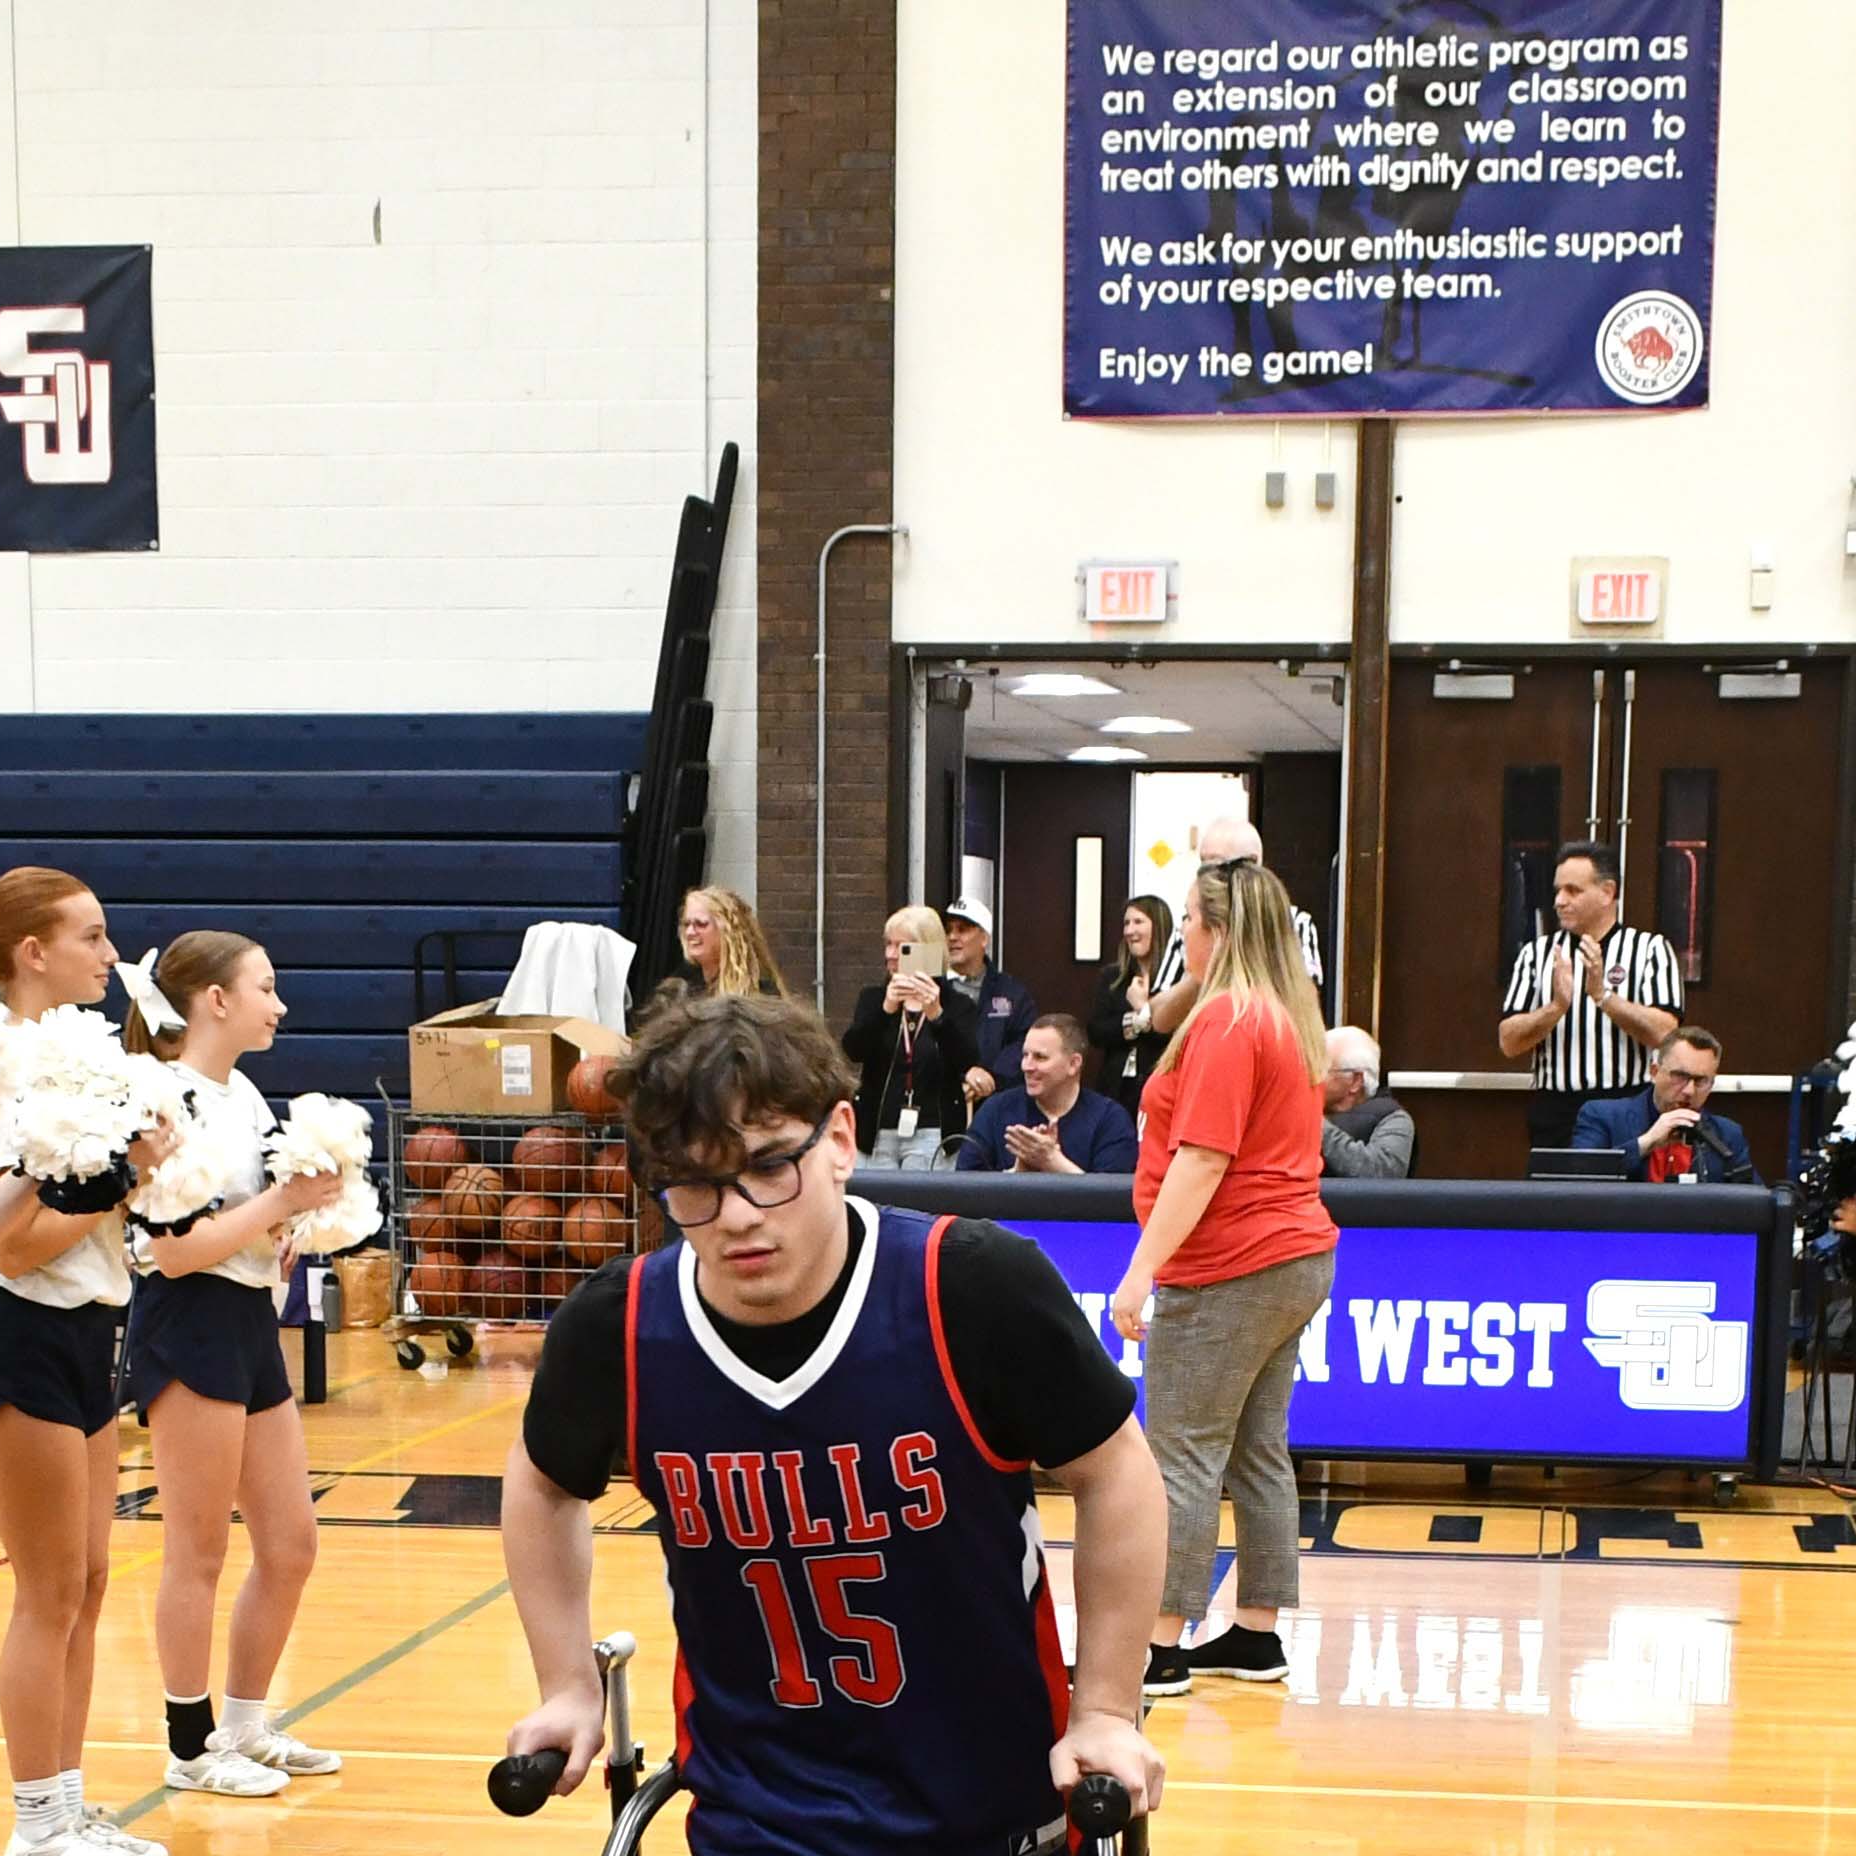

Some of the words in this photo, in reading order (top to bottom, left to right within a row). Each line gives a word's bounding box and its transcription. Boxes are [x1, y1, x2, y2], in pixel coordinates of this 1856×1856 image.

[1102, 45, 1155, 75] We
[1163, 40, 1278, 80] regard
[1287, 45, 1343, 71] our
[1350, 35, 1479, 69] athletic
[1489, 36, 1639, 72] program
[1648, 35, 1688, 61] as
[1101, 89, 1145, 115] an
[1172, 78, 1336, 113] extension
[1364, 75, 1398, 108] of
[1424, 80, 1481, 106] our
[1508, 72, 1687, 104] classroom
[1101, 117, 1311, 154] environment
[1334, 115, 1439, 147] where
[1464, 118, 1515, 143] we
[1541, 110, 1626, 142] learn
[1652, 108, 1686, 140] to
[1100, 161, 1174, 192] treat
[1181, 159, 1278, 188] others
[1286, 155, 1350, 186] with
[1358, 152, 1470, 192] dignity
[1477, 150, 1543, 182] and
[1550, 148, 1683, 188] respect.
[1100, 236, 1152, 266] We
[1159, 234, 1215, 265] ask
[1221, 232, 1265, 264] for
[1271, 236, 1346, 270] your
[1351, 227, 1547, 261] enthusiastic
[1555, 224, 1683, 263] support
[1099, 273, 1133, 305] of
[1137, 278, 1213, 311] your
[1217, 268, 1396, 308] respective
[1403, 268, 1501, 299] team.
[1099, 346, 1189, 385] Enjoy
[1199, 346, 1252, 376] the
[1263, 343, 1373, 383] game!
[1100, 571, 1155, 614] EXIT
[1592, 573, 1649, 617] EXIT
[1348, 1298, 1567, 1388] WEST
[653, 1430, 948, 1549] BULLS
[740, 1551, 907, 1710] 15
